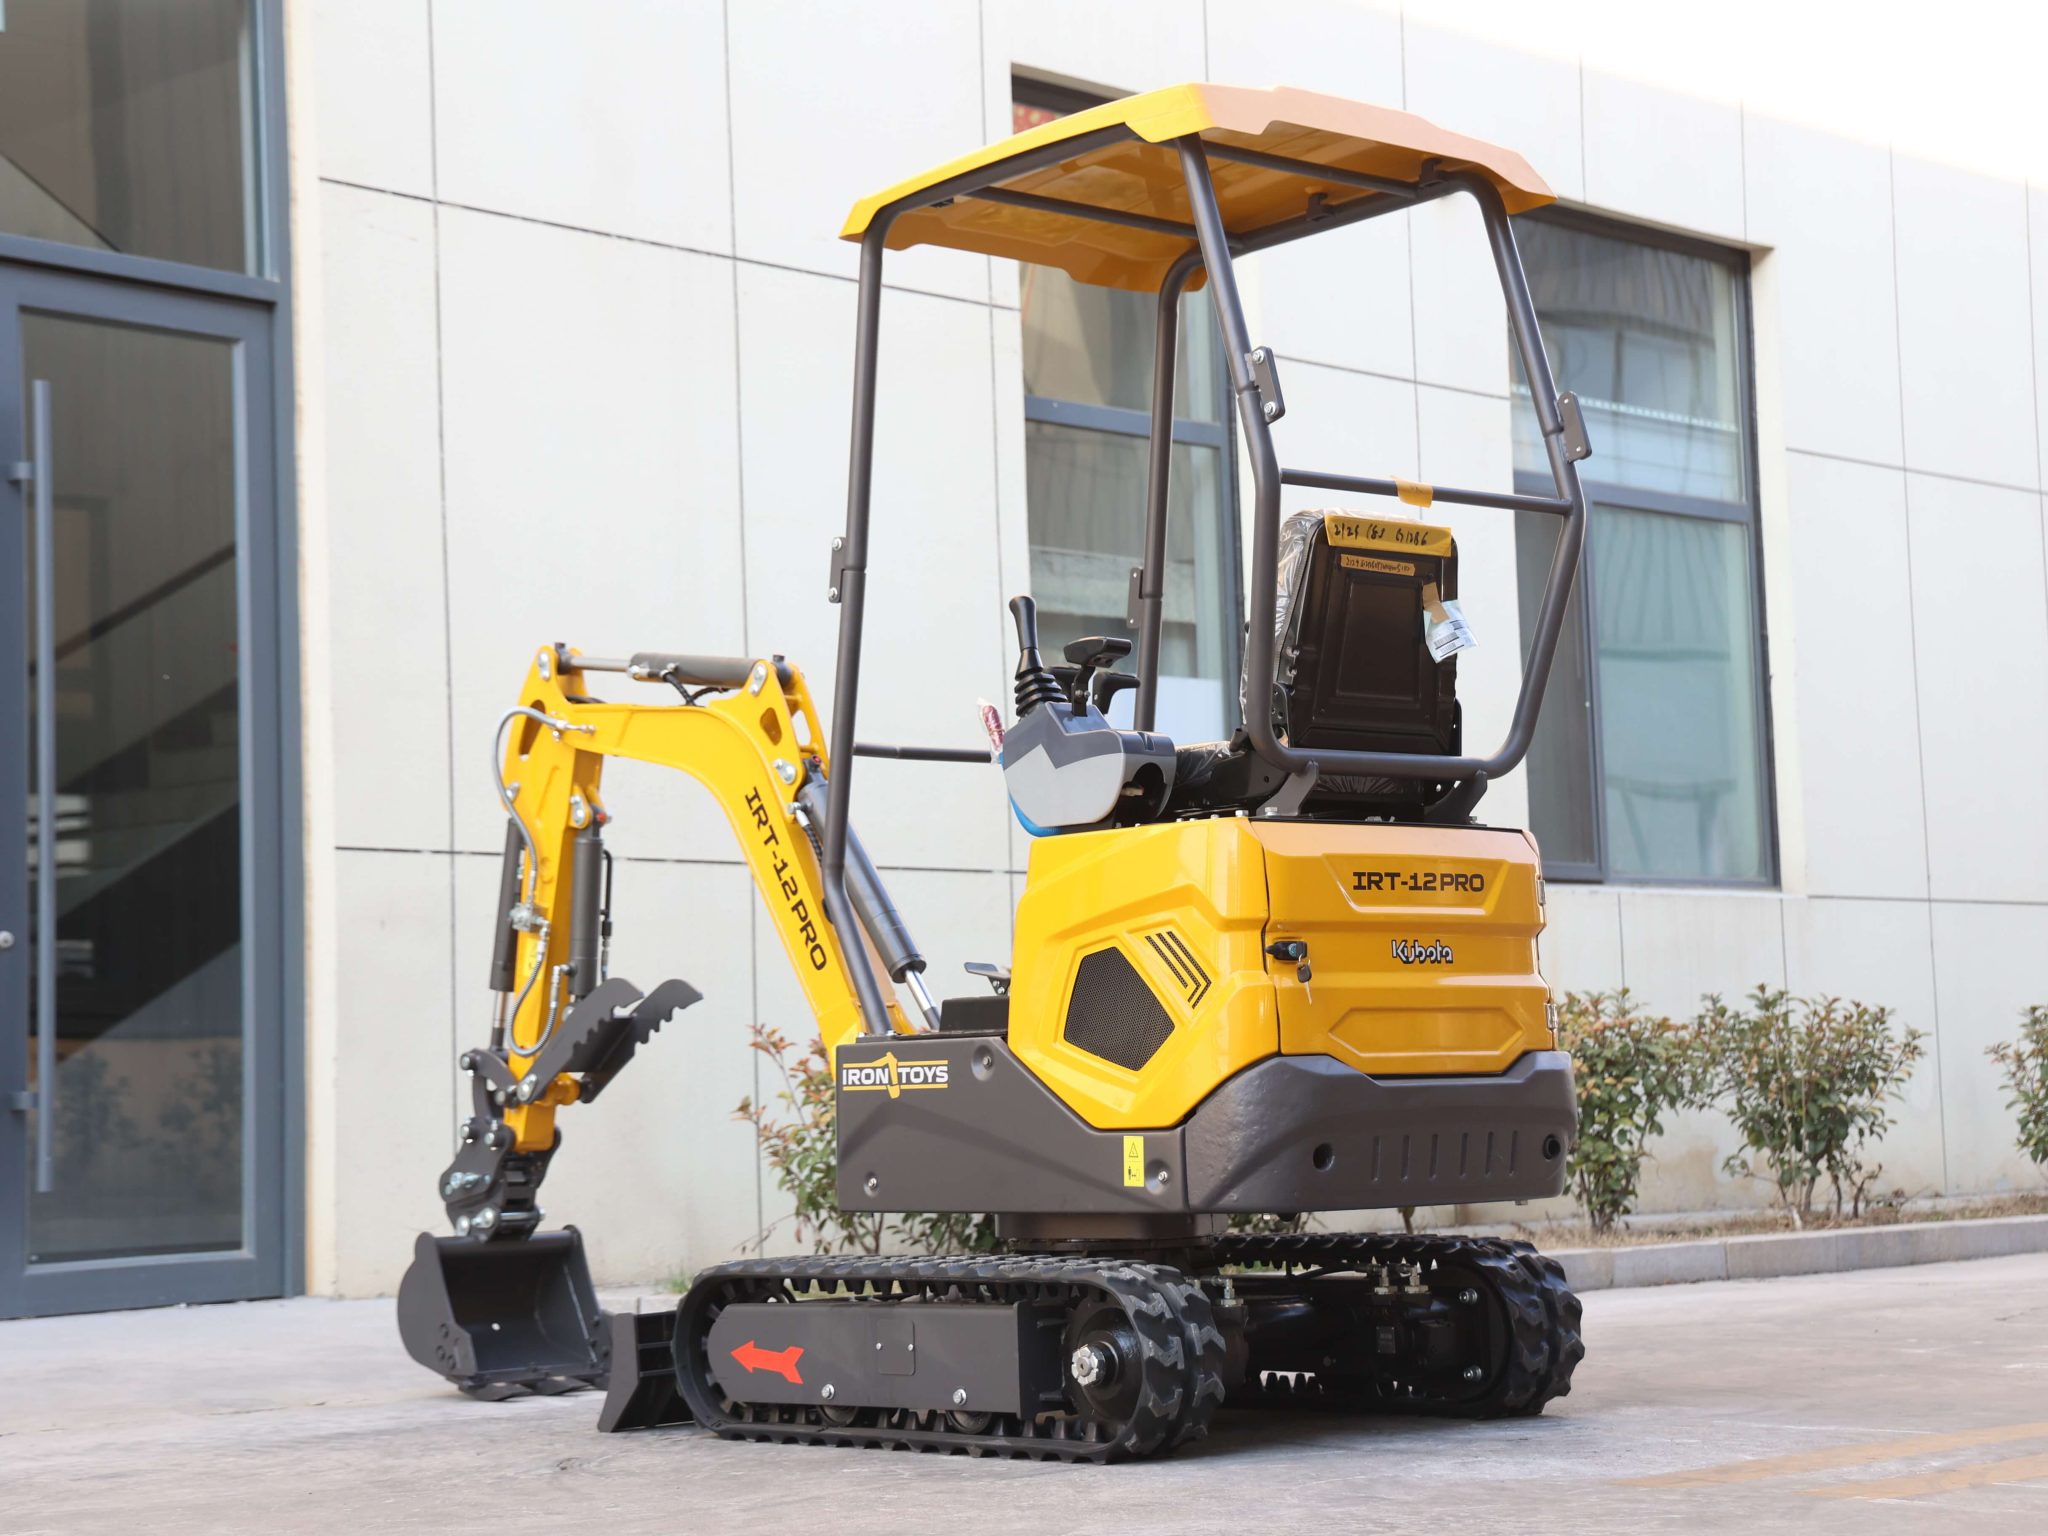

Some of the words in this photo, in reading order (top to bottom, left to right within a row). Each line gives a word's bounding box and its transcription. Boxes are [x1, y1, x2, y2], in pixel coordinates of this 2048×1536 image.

[1391, 939, 1454, 965] Kubota
[842, 1067, 889, 1086] IRON
[897, 1065, 949, 1084] TOYS
